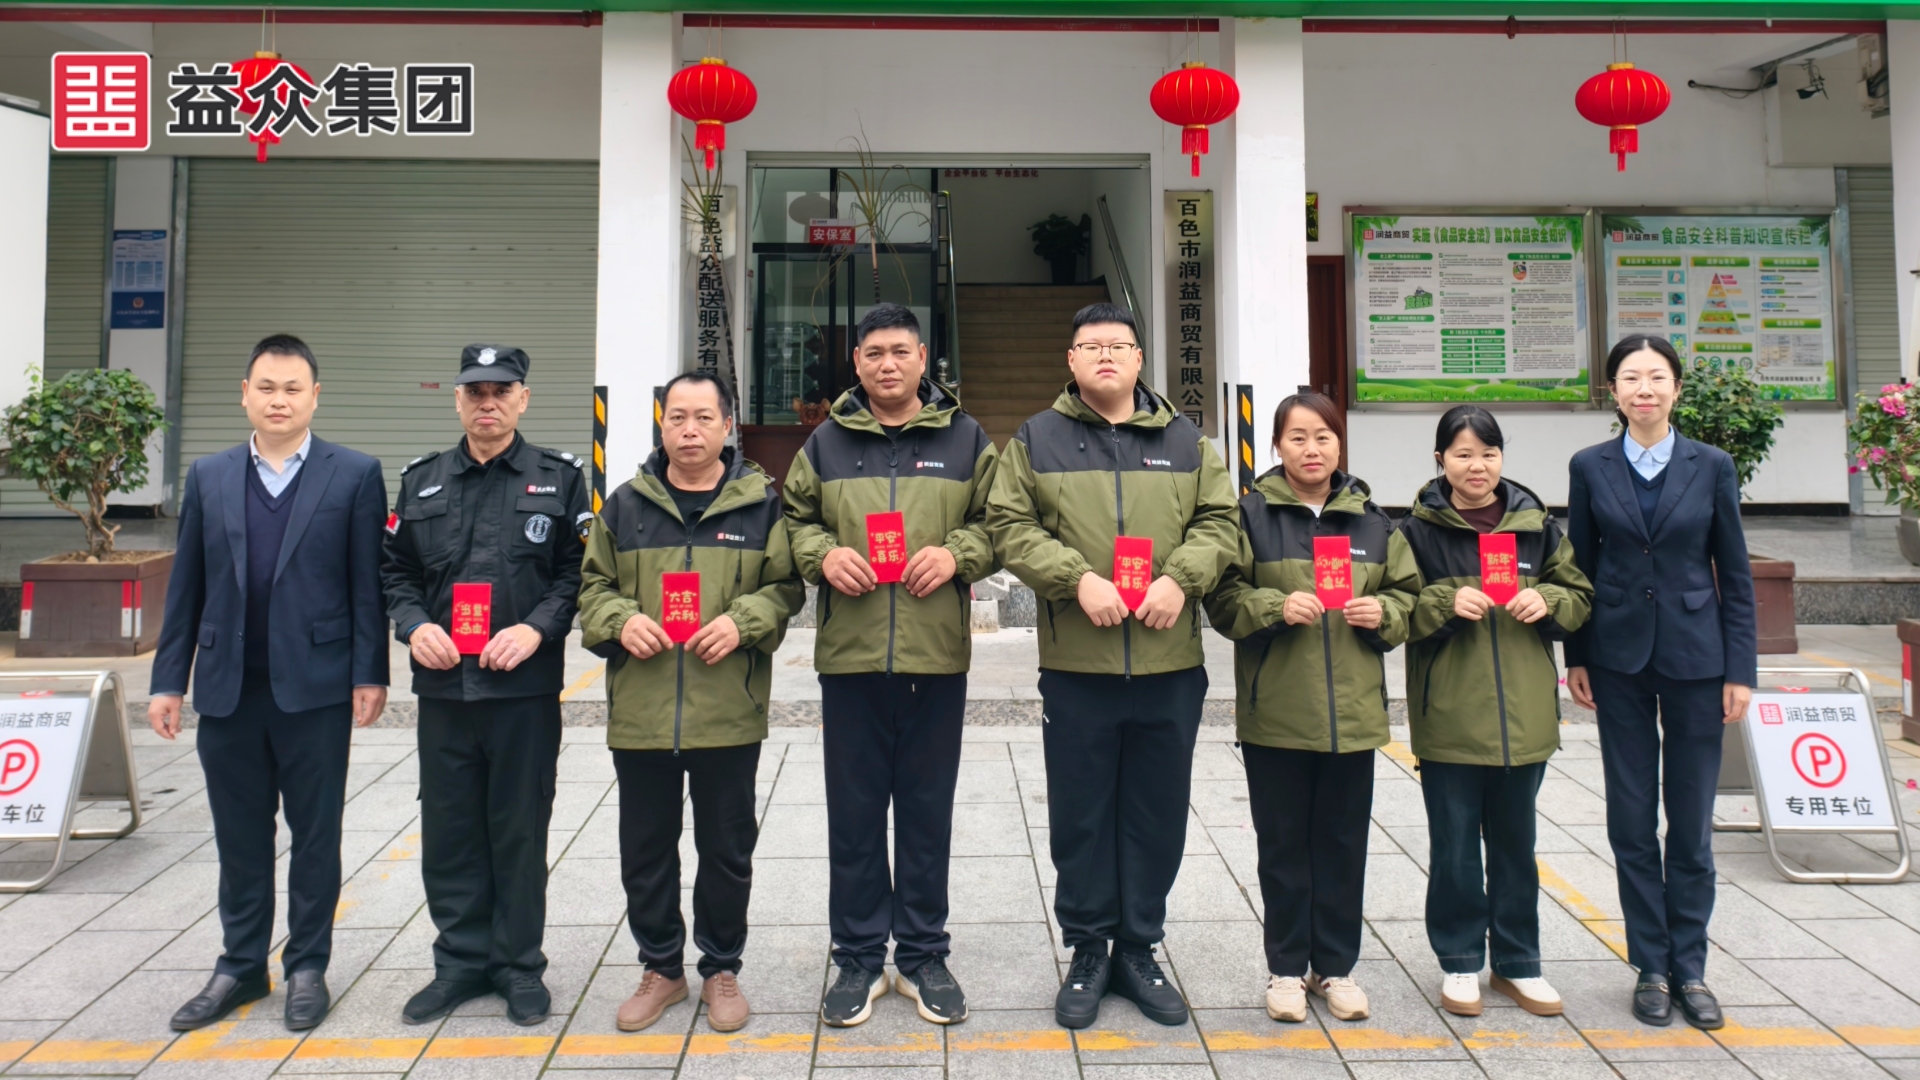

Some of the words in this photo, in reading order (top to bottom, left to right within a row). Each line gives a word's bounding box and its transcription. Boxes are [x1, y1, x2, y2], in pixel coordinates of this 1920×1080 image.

[813, 228, 852, 241] 安保室
[1375, 230, 1410, 240] 润益商贸
[1625, 233, 1659, 242] 润益商贸
[1661, 226, 1811, 245] 食品安全科普知识宣传栏
[1404, 295, 1433, 310] 食品安
[1177, 198, 1204, 428] 百色市润益商贸有限公司
[875, 531, 897, 544] 平安
[877, 550, 899, 563] 喜乐
[1122, 557, 1144, 570] 平安
[1487, 553, 1510, 566] 新年
[1121, 575, 1143, 589] 喜乐
[669, 590, 693, 603] 大吉
[670, 609, 695, 621] 大利
[0, 711, 72, 729] 润益商贸
[1785, 706, 1857, 723] 润益商贸
[1, 752, 26, 785] P
[1809, 746, 1832, 777] P
[1785, 796, 1874, 816] 专用车位
[2, 803, 46, 824] 车位
